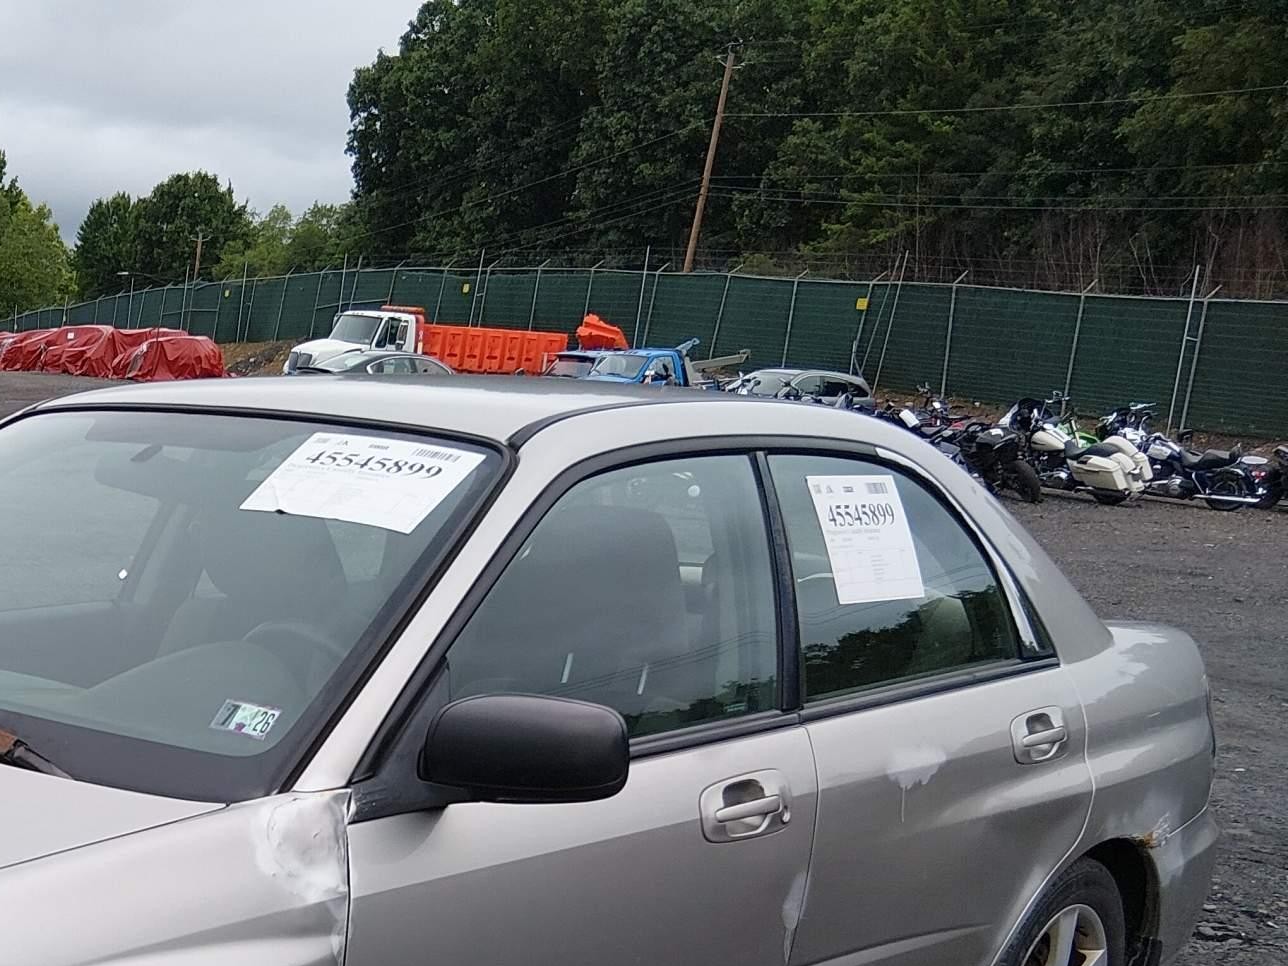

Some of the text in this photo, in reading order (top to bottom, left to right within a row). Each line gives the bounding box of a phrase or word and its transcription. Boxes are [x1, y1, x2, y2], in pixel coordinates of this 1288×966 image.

[306, 451, 443, 479] 45545899
[828, 503, 895, 527] 45545899
[253, 711, 275, 734] 26
